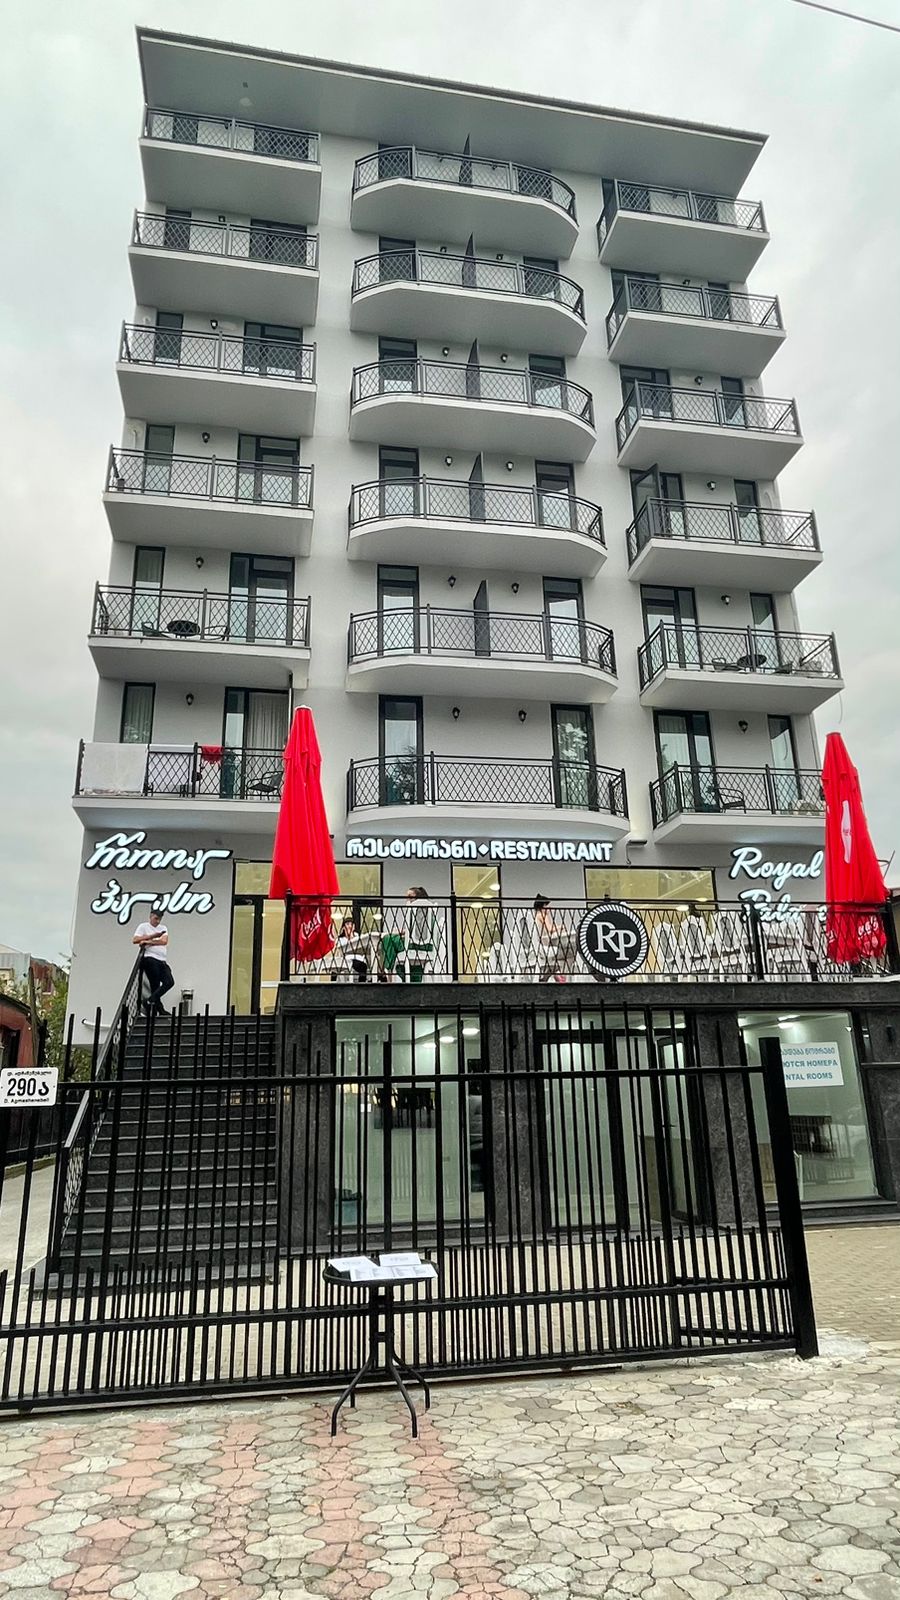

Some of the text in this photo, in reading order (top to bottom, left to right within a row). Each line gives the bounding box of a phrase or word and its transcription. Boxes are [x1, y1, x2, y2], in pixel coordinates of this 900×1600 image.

[346, 838, 613, 861] რესტორანი RESTAURANT
[730, 847, 824, 890] Royal
[739, 889, 827, 923] Palae
[593, 921, 637, 961] RP
[806, 1072, 833, 1080] ROOMS
